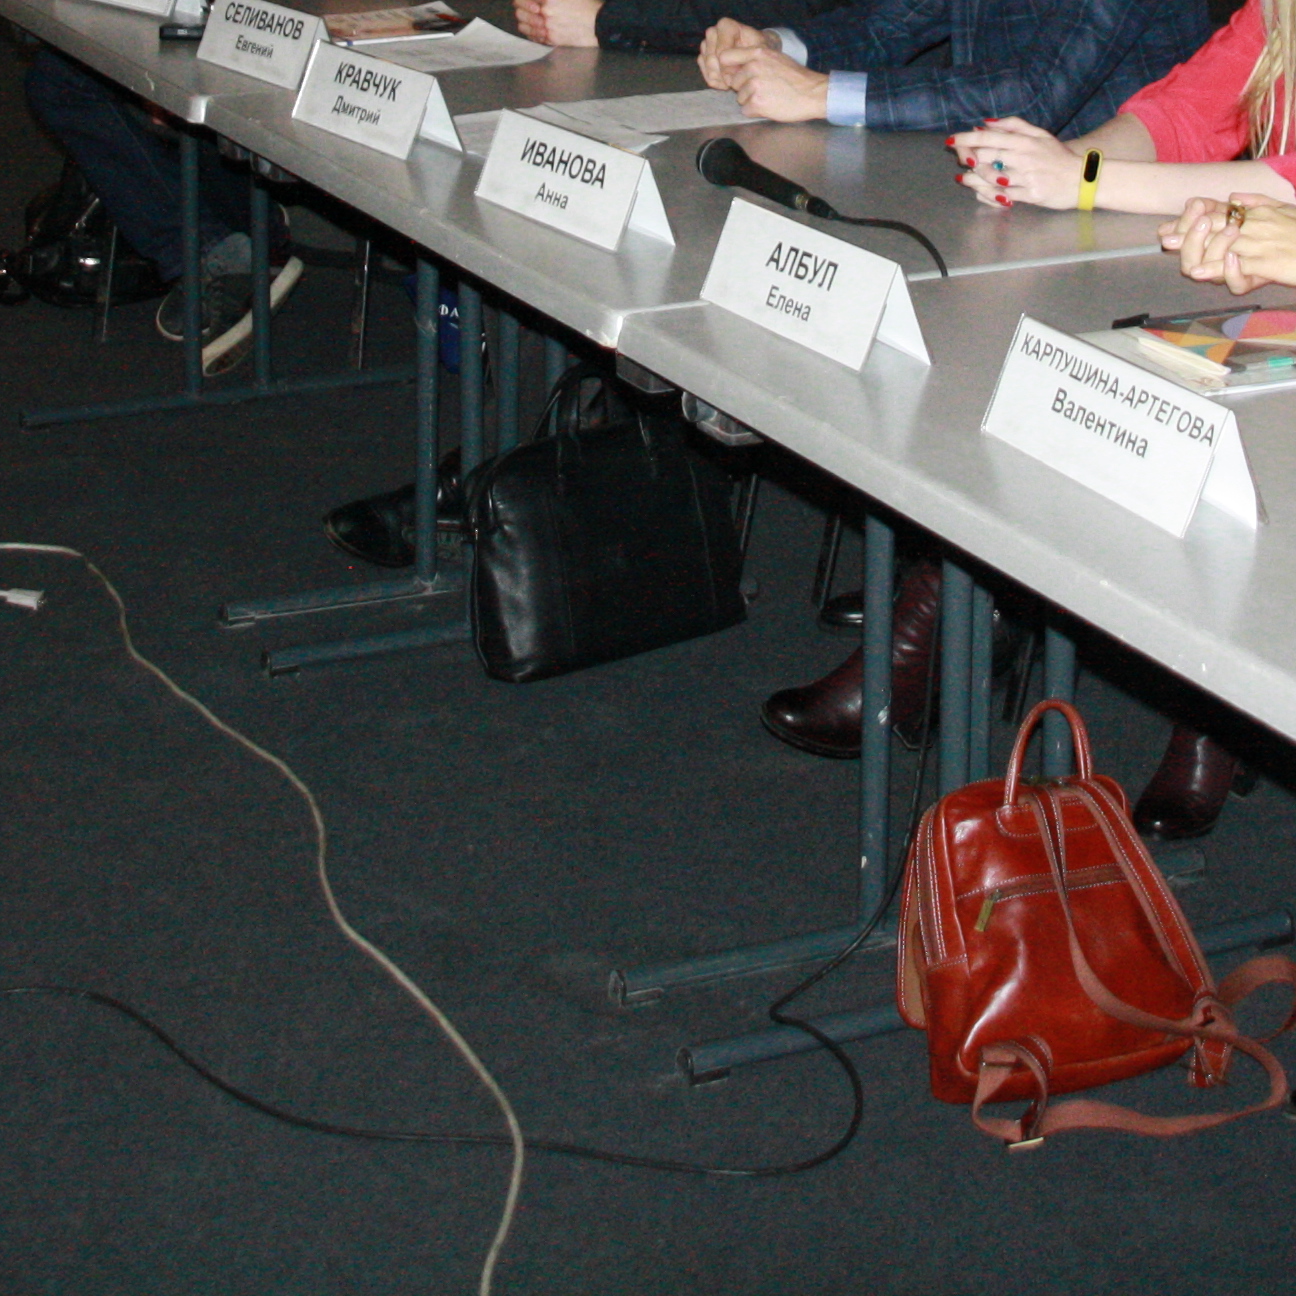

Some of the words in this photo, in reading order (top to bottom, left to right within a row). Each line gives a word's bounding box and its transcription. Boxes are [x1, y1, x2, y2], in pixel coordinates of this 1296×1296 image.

[224, 1, 304, 41] СЕЛИВАНОВ
[235, 33, 274, 59] Евгений
[333, 60, 403, 103] КРАВЧУК
[331, 94, 381, 127] Дмитрий
[520, 136, 607, 189] ИВАНОВА
[534, 180, 569, 211] Анна
[765, 241, 839, 292] АЛБУЛ
[765, 285, 812, 323] Елена
[1020, 331, 1216, 448] КАРПУШИНА-АРТЕГОВА
[1050, 386, 1149, 460] Валентина
